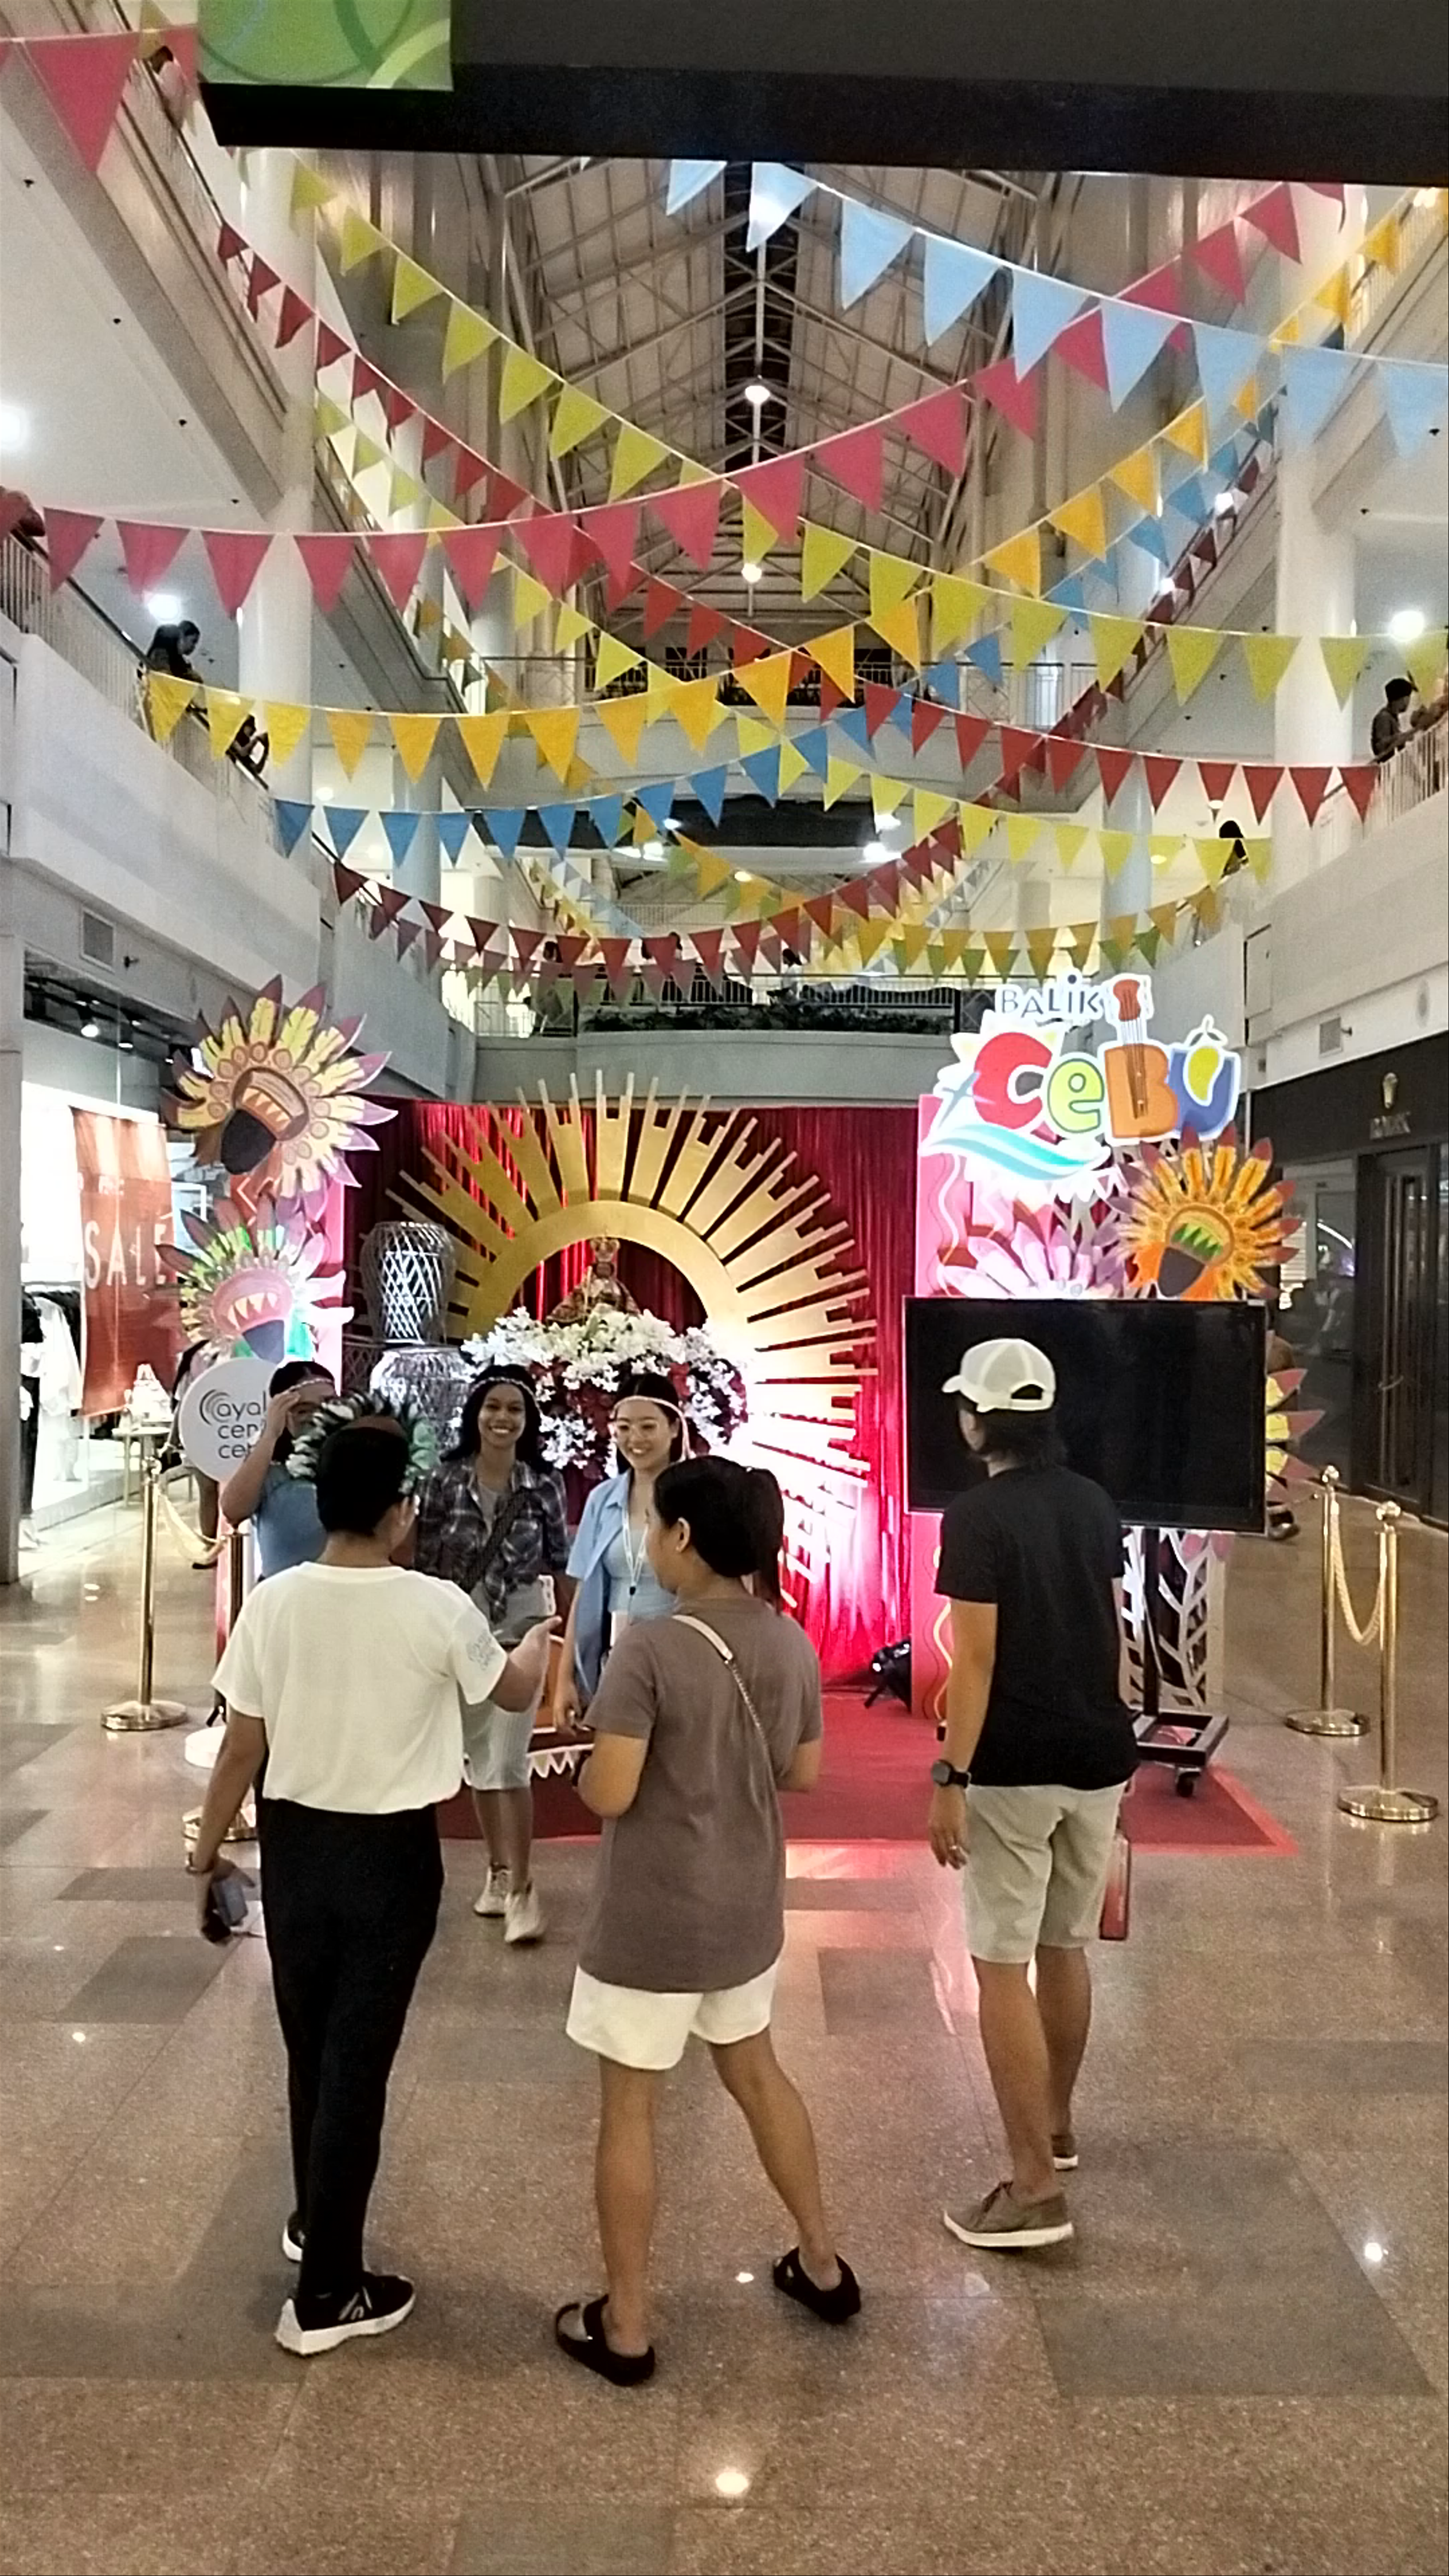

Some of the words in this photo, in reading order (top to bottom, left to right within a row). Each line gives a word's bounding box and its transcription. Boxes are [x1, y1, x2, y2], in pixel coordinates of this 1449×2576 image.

[85, 1221, 166, 1289] SALE
[216, 1390, 266, 1421] ayal
[218, 1423, 259, 1439] cen
